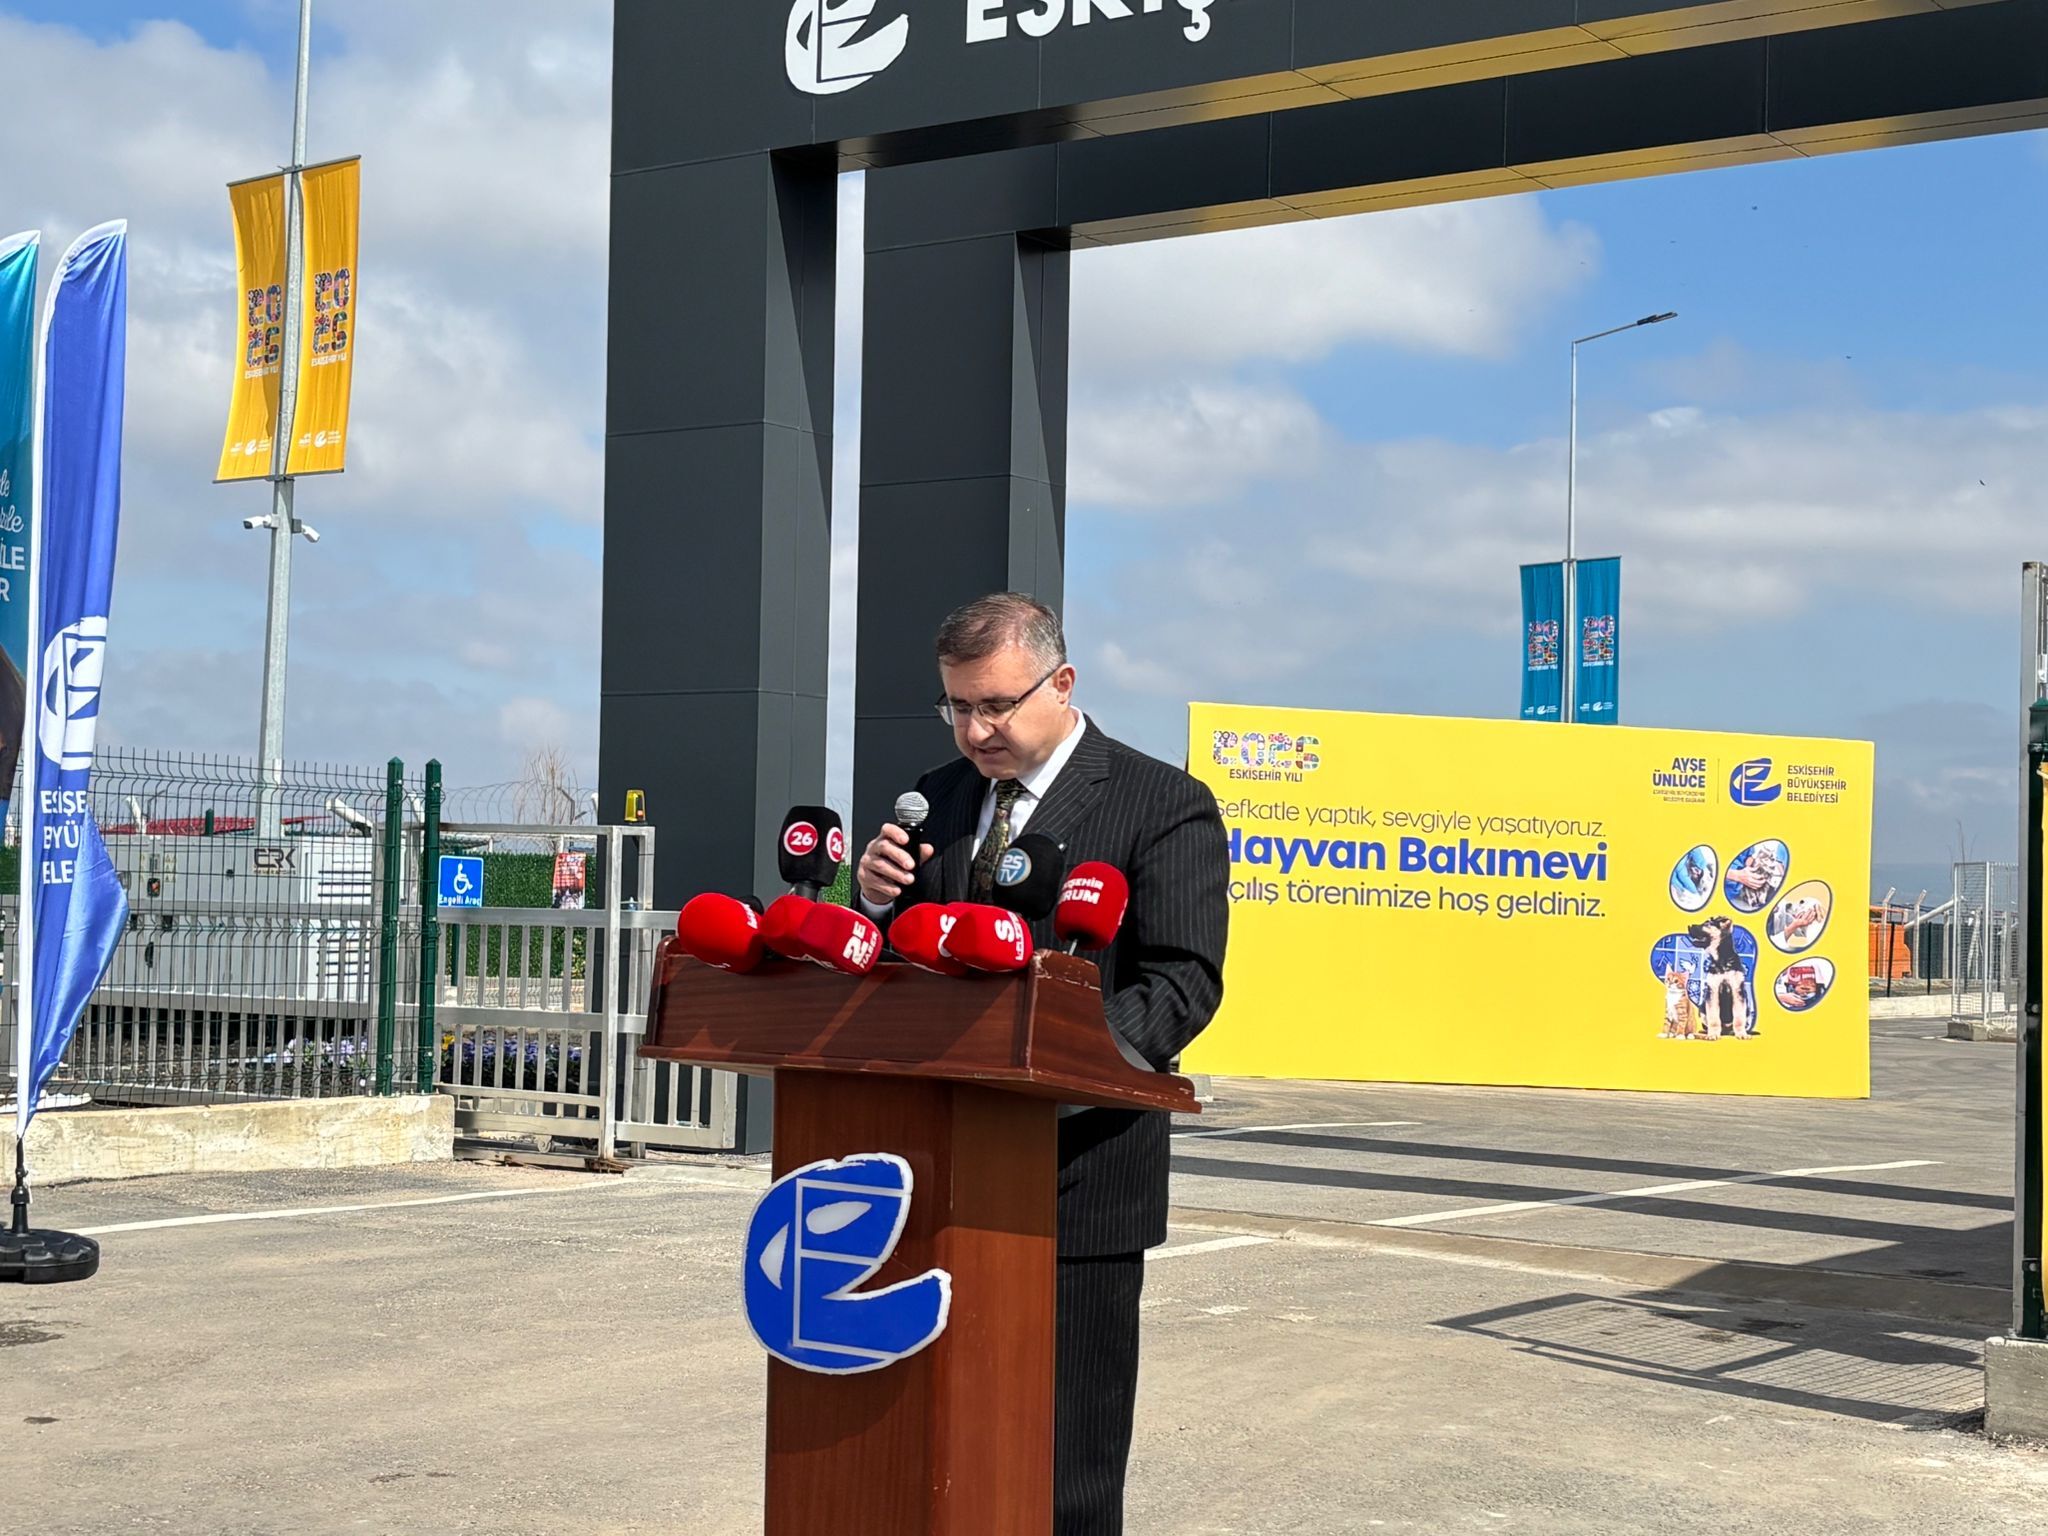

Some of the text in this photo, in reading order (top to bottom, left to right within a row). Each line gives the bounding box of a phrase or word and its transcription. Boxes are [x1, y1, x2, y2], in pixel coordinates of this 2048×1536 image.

[1672, 757, 1706, 773] AYŞE
[1787, 764, 1835, 776] ESKİŞEHİR
[1285, 772, 1303, 783] YILI
[1787, 777, 1847, 790] BÜYÜKŞEHİR
[1787, 791, 1839, 803] BELEDİYESİ
[1305, 806, 1377, 828] yaptık,
[1382, 809, 1472, 833] sevgiyle
[1477, 816, 1607, 839] yaşatıyoruz.
[790, 831, 813, 846] 26
[1399, 837, 1608, 881] Bakımevi
[1000, 869, 1019, 882] TV
[1227, 876, 1606, 919] çılış törenimize hoş geldiniz.
